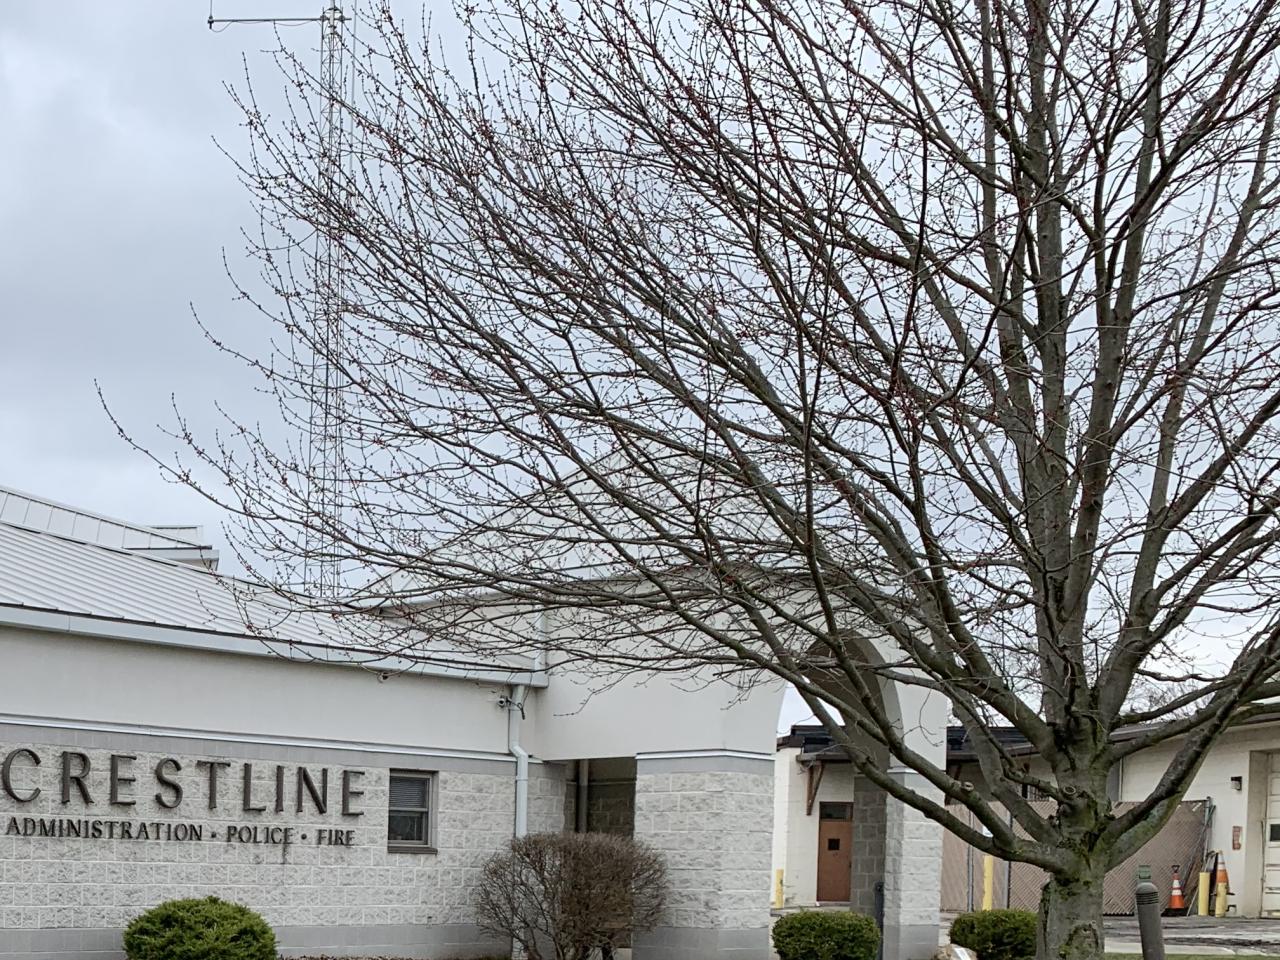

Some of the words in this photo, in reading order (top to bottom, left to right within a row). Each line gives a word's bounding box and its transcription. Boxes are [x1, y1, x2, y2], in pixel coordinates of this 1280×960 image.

[0, 748, 365, 817] CRESTLINE
[6, 816, 203, 843] ADMINISTRATION
[225, 825, 295, 845] POLICE
[317, 829, 356, 846] FIRE
